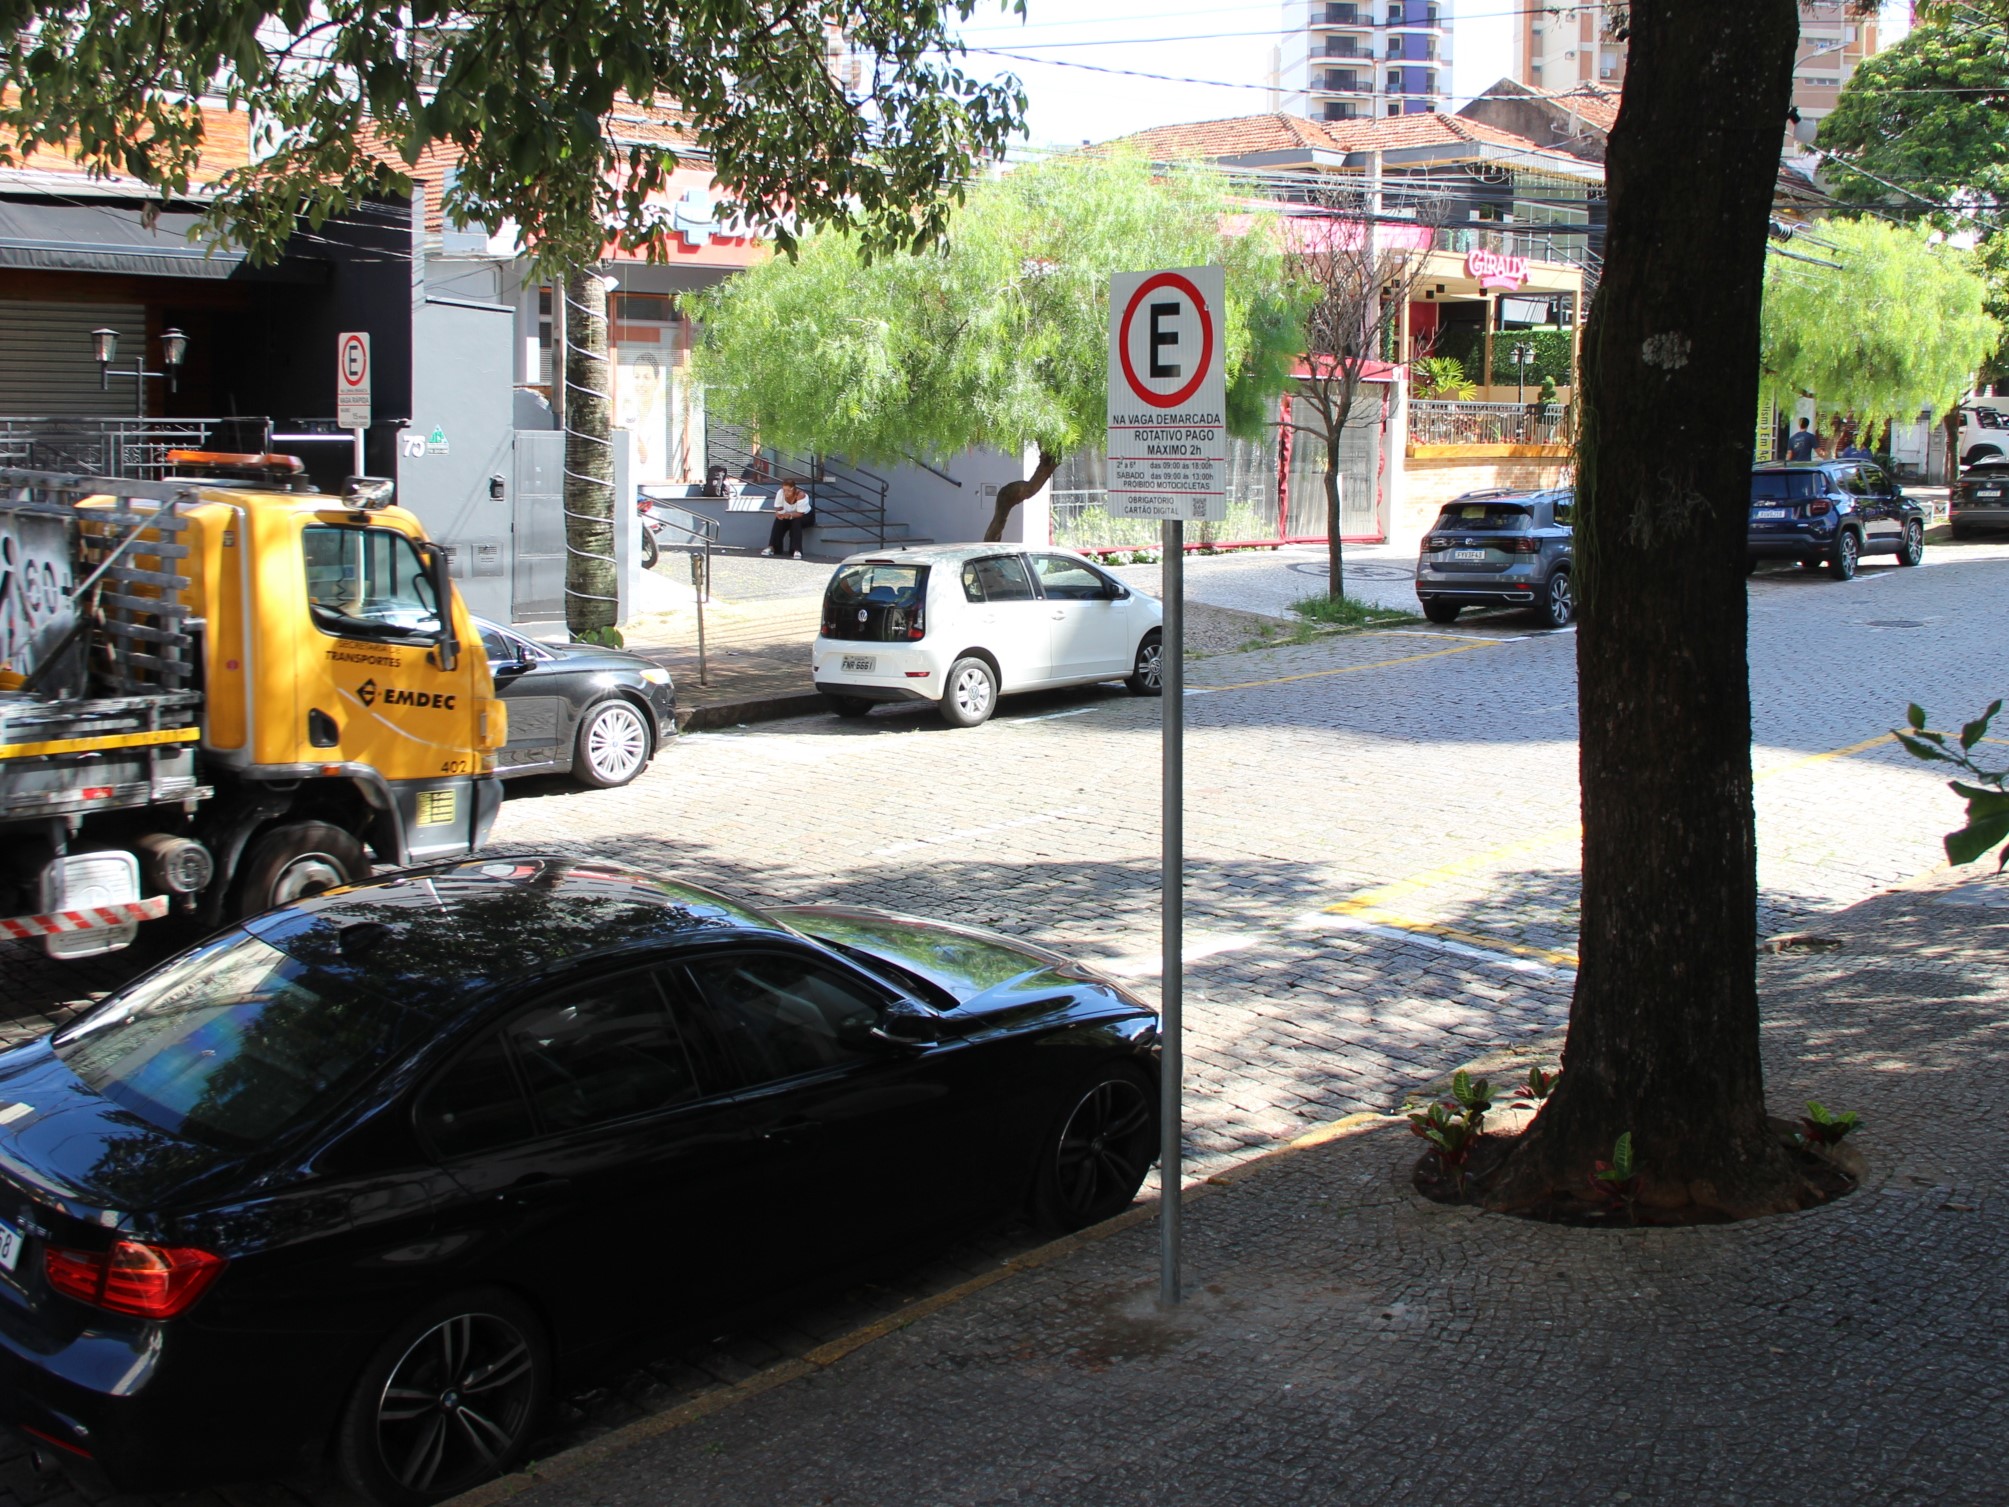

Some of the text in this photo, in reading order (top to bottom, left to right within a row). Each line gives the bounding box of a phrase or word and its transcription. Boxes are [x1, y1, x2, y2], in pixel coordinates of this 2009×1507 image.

[1150, 302, 1181, 378] E
[349, 345, 359, 376] E
[1113, 413, 1221, 425] NA VAGA DEMARCADA
[1134, 429, 1215, 441] ROTATIVO PAGO
[403, 435, 426, 458] 75
[1190, 444, 1202, 456] 2h
[1150, 462, 1161, 470] das
[1162, 462, 1181, 470] 09:00
[1192, 462, 1213, 470] 18:00h
[1151, 472, 1162, 480] das
[1163, 472, 1181, 480] 09:00
[1192, 473, 1214, 481] 13:00h
[1123, 480, 1210, 490] PROIBIDO MOTOCICLETAS
[1124, 505, 1179, 516] CARTÃO DIGITAL
[326, 650, 401, 668] TRANSPORTES
[384, 689, 457, 710] EMDEC
[441, 760, 467, 773] 402
